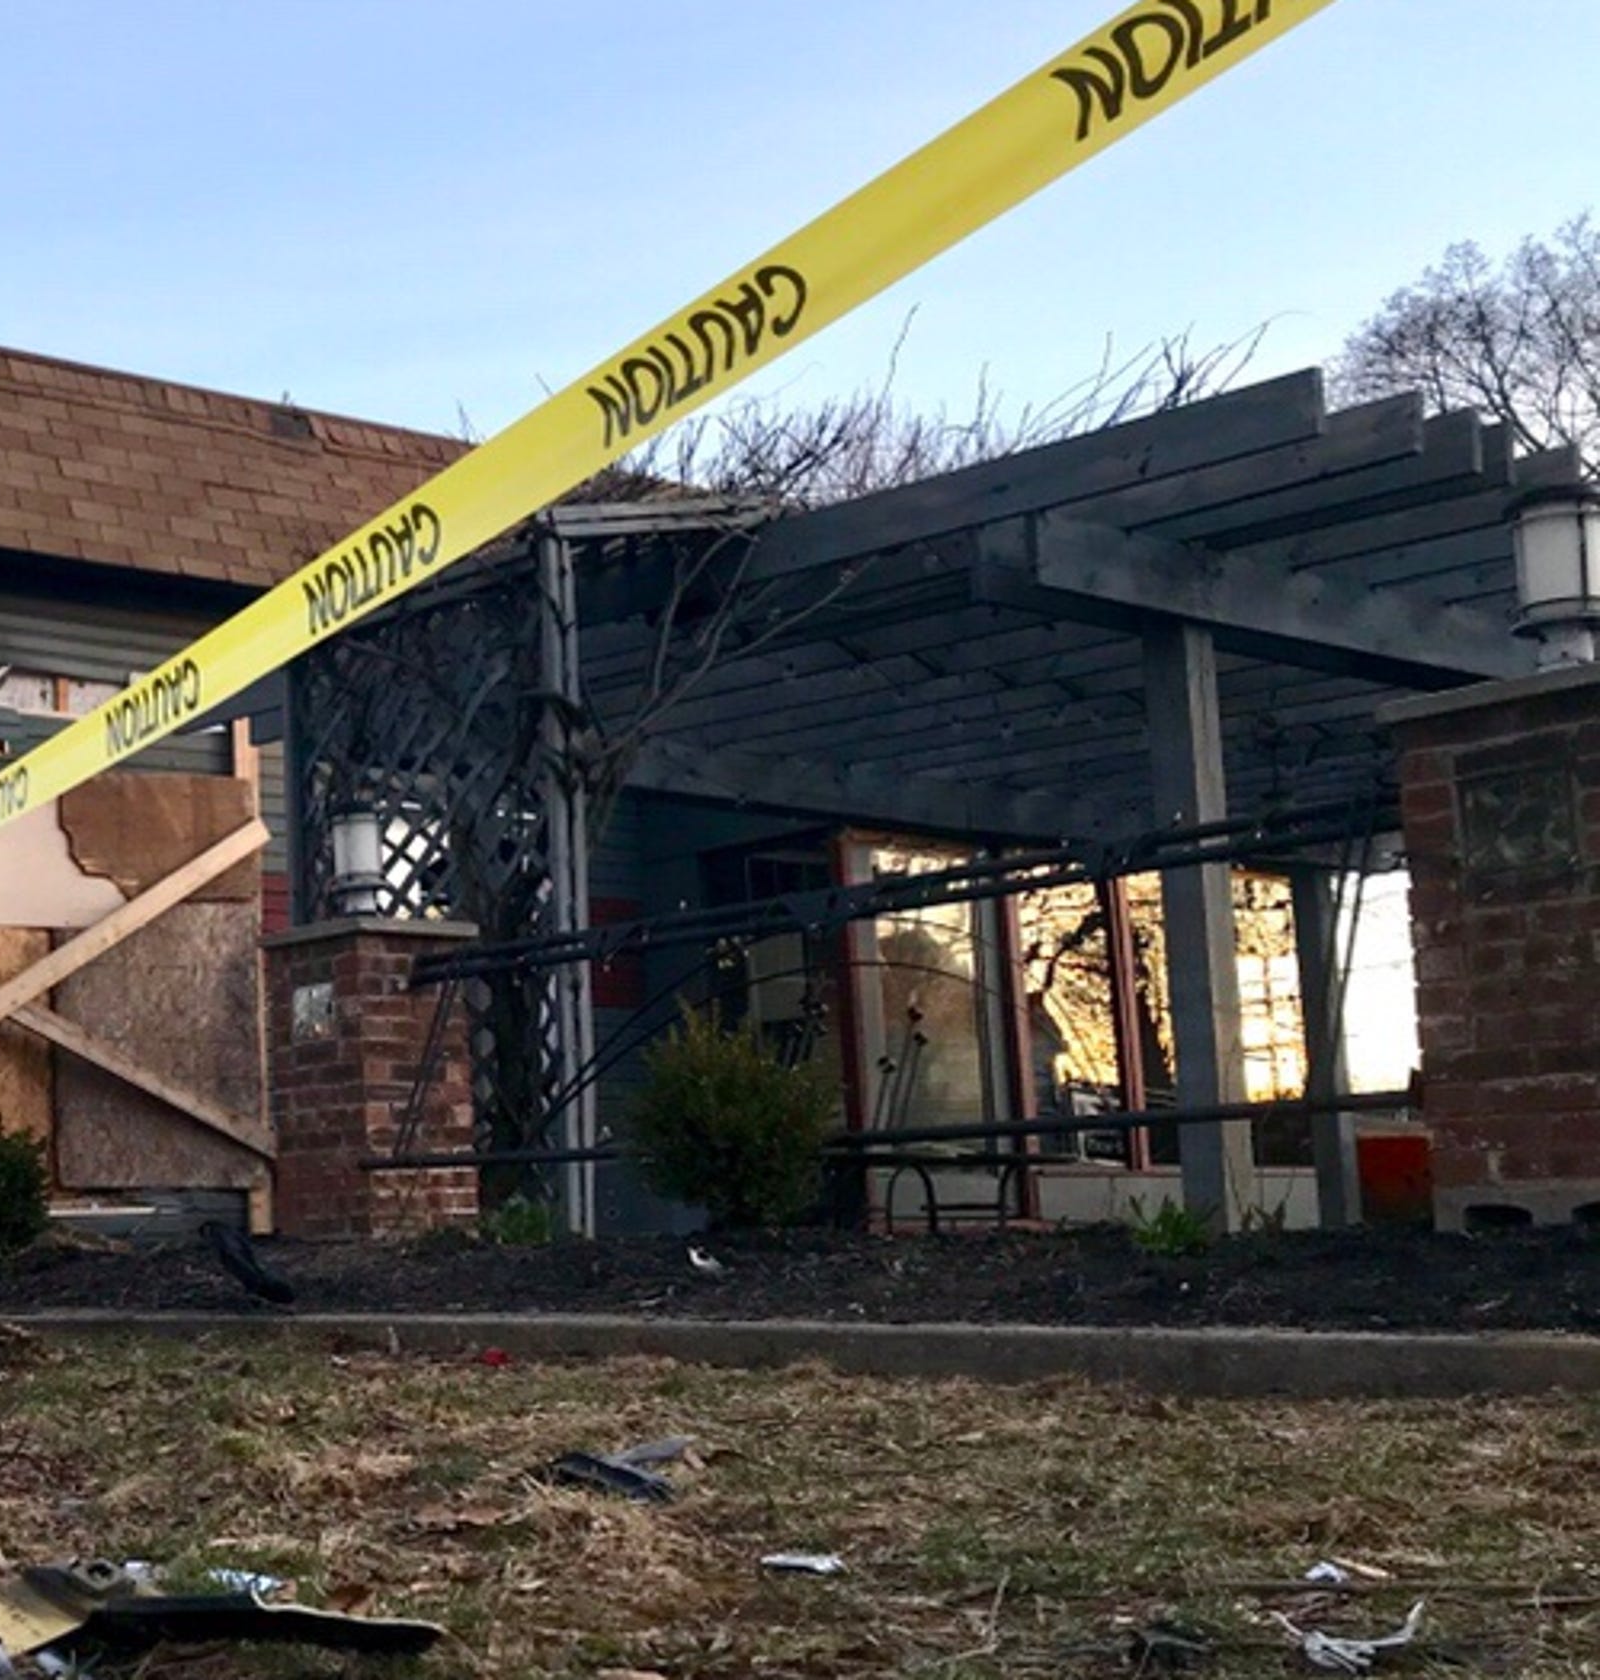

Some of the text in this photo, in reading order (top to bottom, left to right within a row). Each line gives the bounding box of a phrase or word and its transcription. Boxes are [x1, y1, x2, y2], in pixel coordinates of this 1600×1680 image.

[1050, 0, 1269, 142] TION
[586, 264, 806, 448] CAUTION
[302, 503, 441, 635] CAUTION
[103, 658, 200, 757] CAUTION
